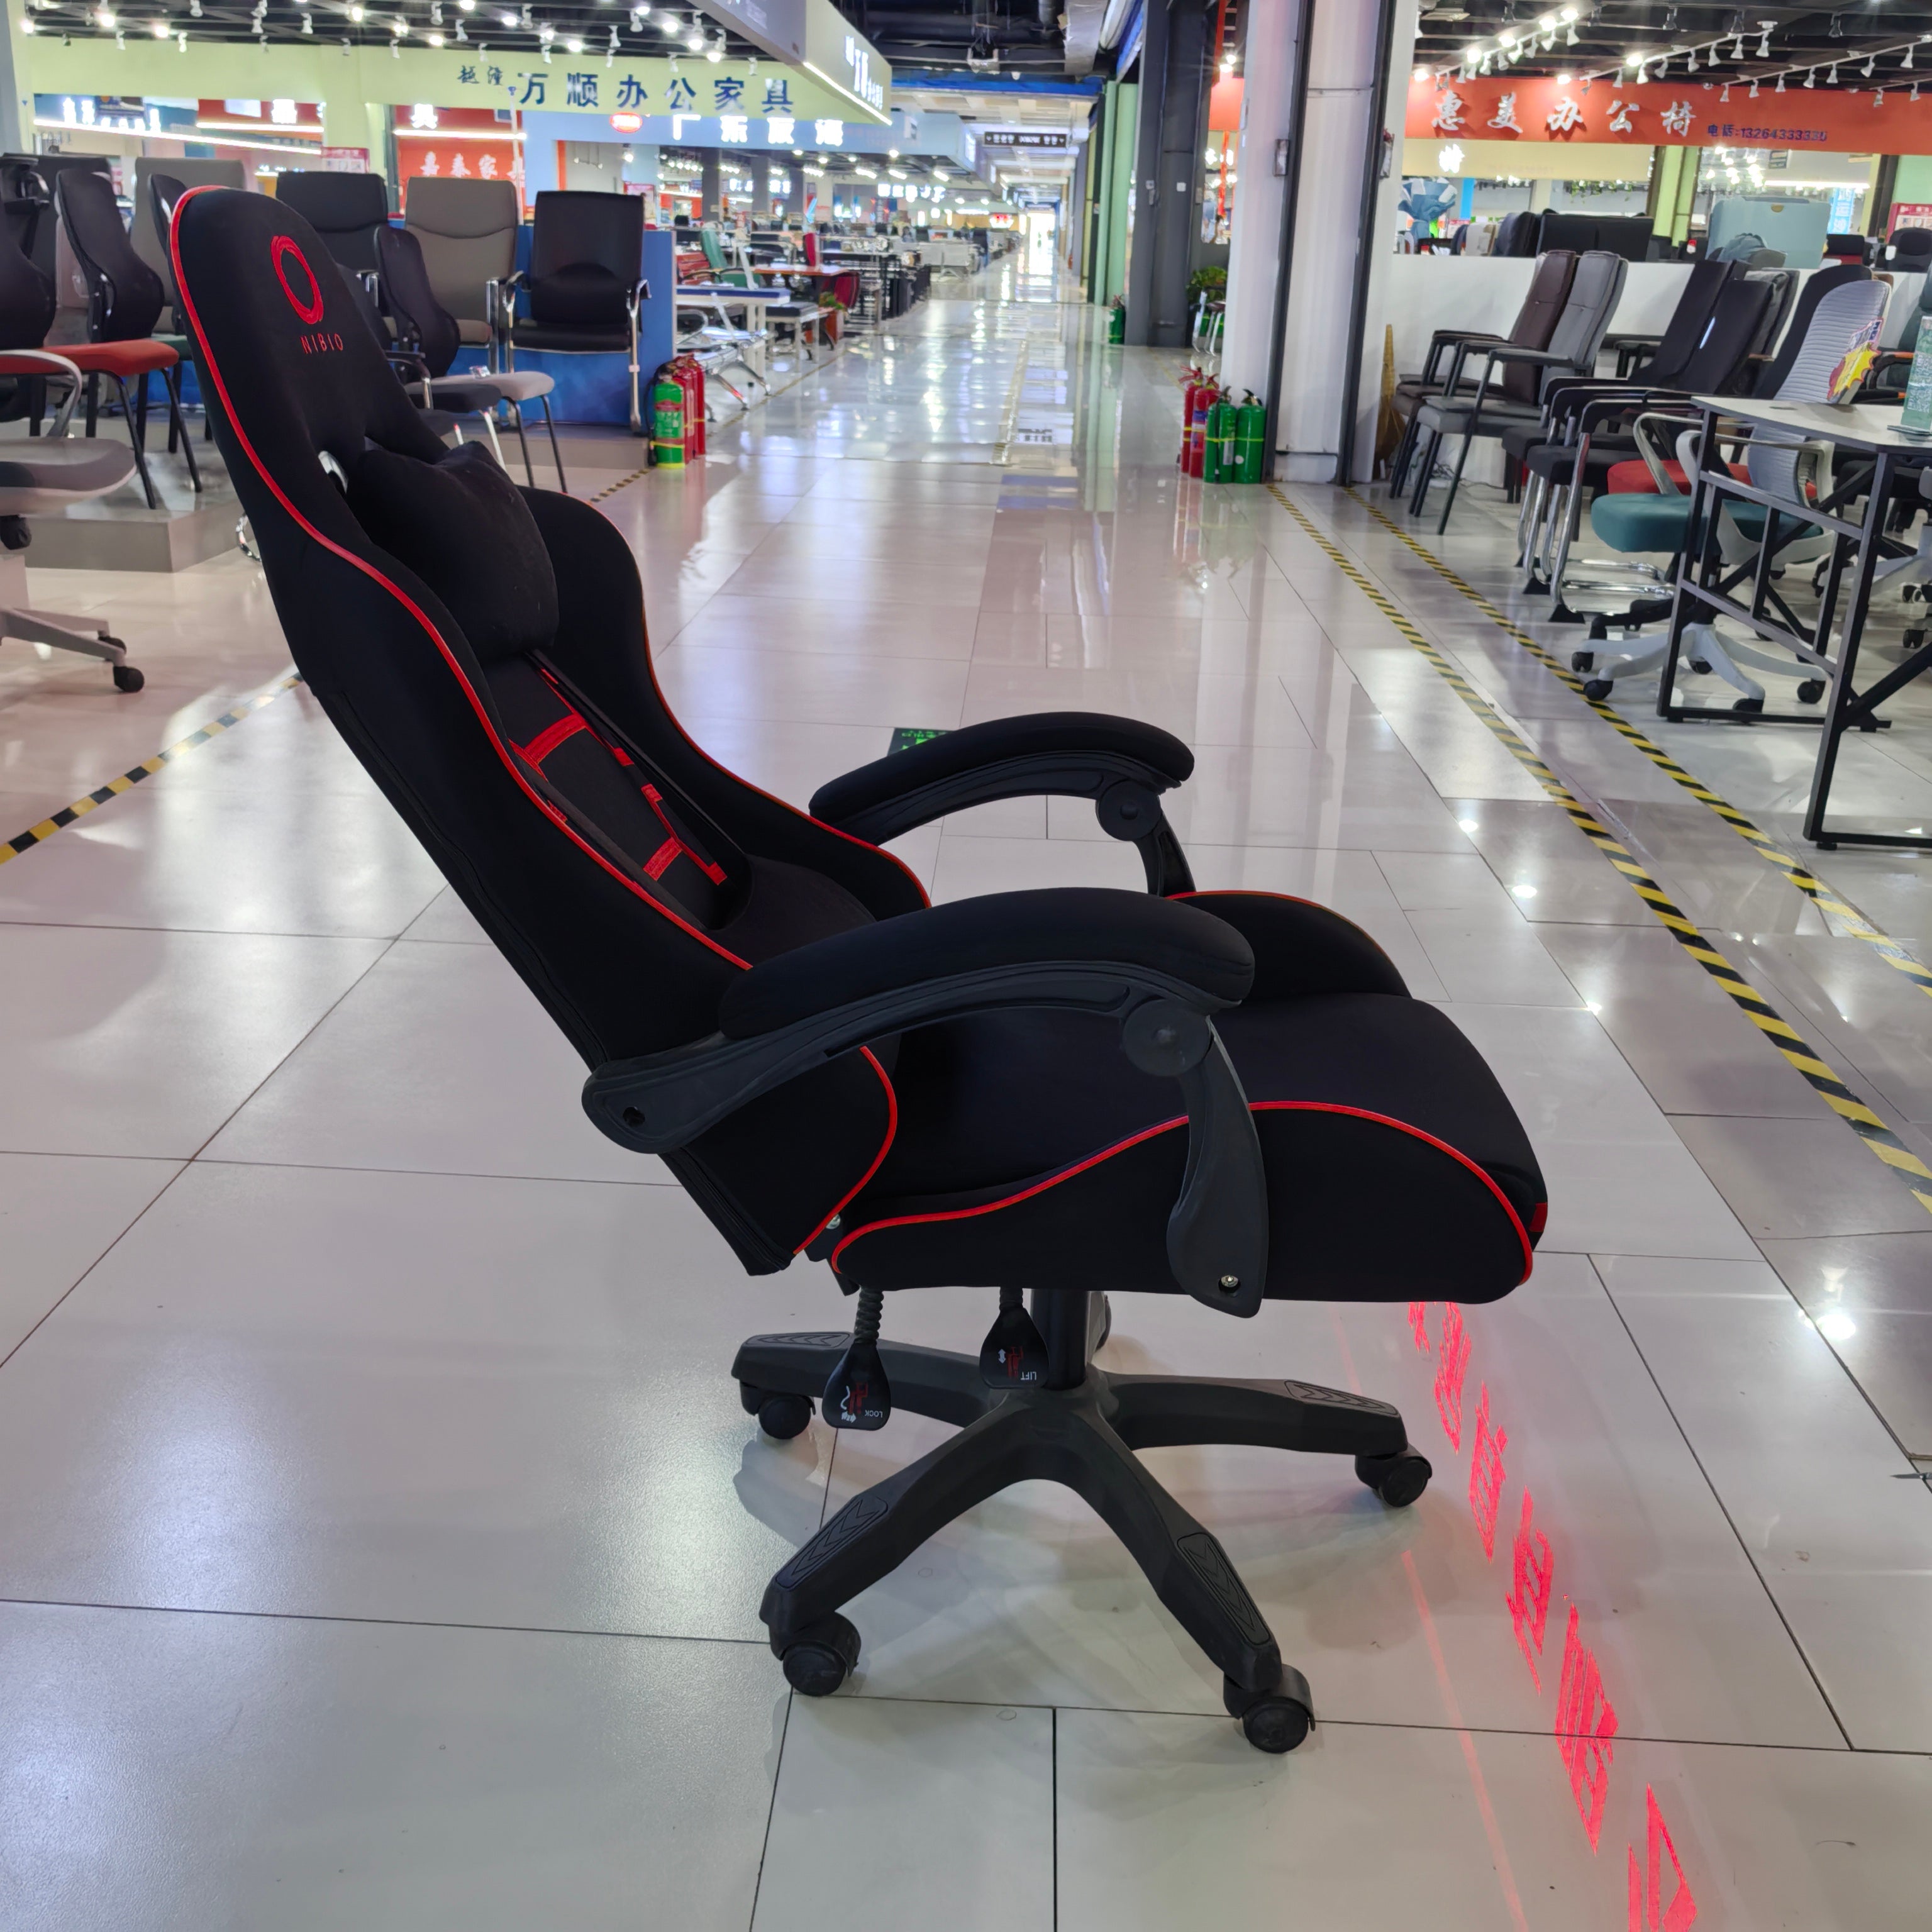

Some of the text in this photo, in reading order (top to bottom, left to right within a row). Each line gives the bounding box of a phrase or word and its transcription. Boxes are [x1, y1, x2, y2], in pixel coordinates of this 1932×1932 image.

[518, 72, 794, 113] 万顺办公家具
[1431, 90, 1696, 137] 惠美办公椅
[300, 333, 343, 354] NIBIO
[1020, 1371, 1037, 1380] LIFT
[865, 1409, 883, 1418] LOCK
